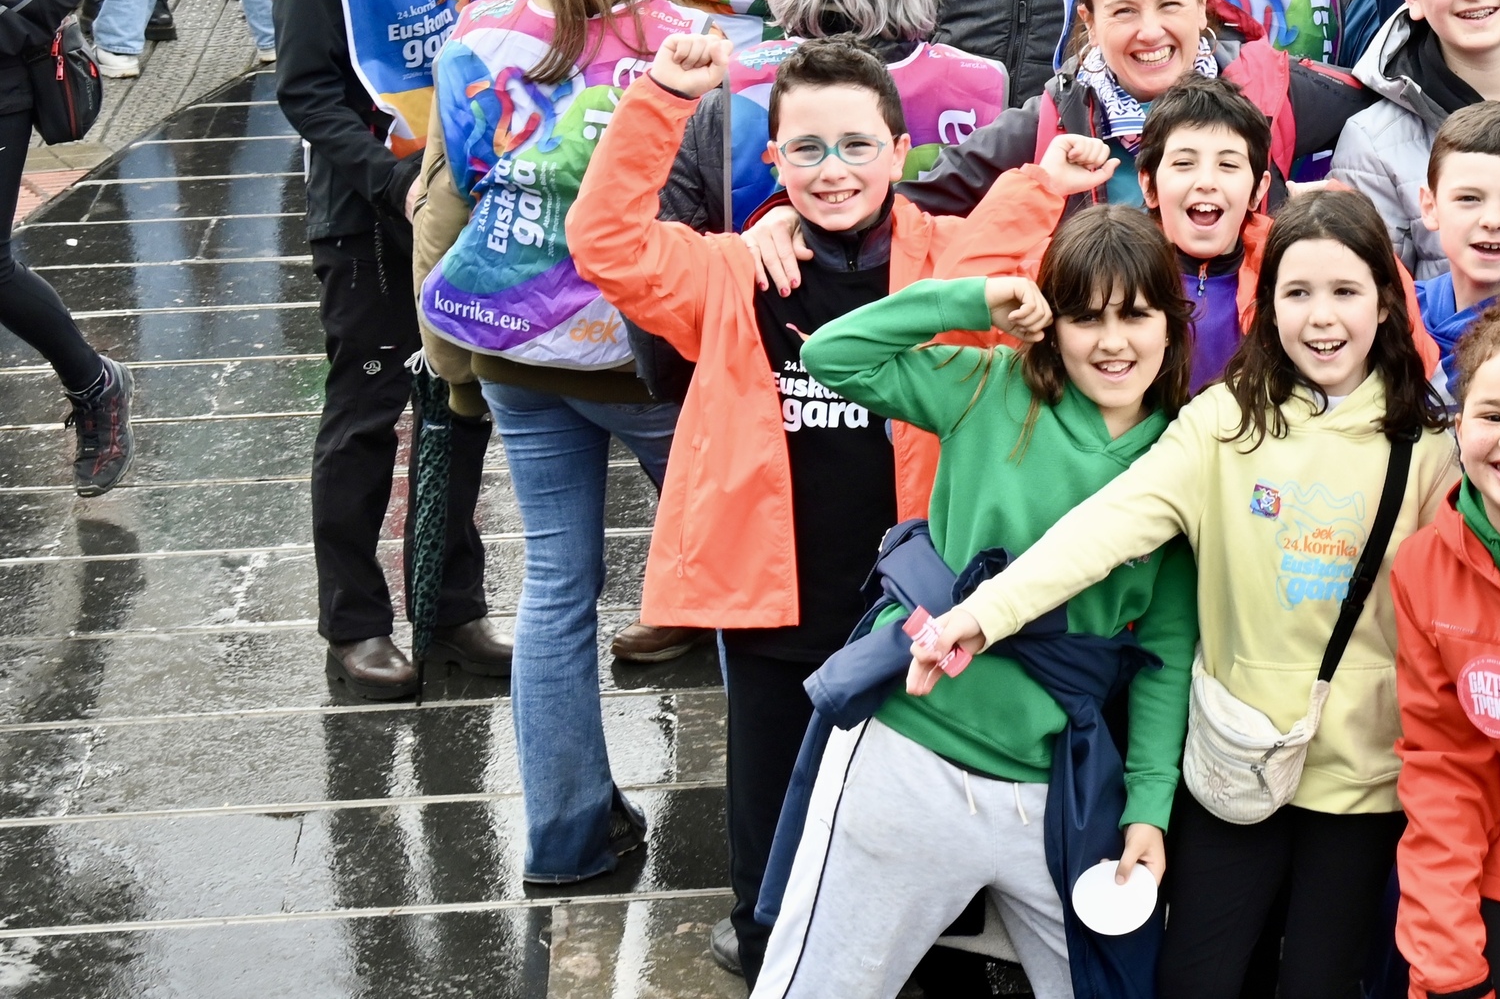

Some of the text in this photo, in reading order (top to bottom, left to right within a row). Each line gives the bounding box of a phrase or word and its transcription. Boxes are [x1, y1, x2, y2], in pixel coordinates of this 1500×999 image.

[487, 158, 512, 254] Euskara
[512, 159, 545, 249] gara
[434, 290, 530, 333] korrika.eus
[570, 310, 622, 344] aek
[782, 398, 869, 432] gara
[1282, 535, 1358, 557] 24.korrika
[1311, 525, 1335, 541] aek
